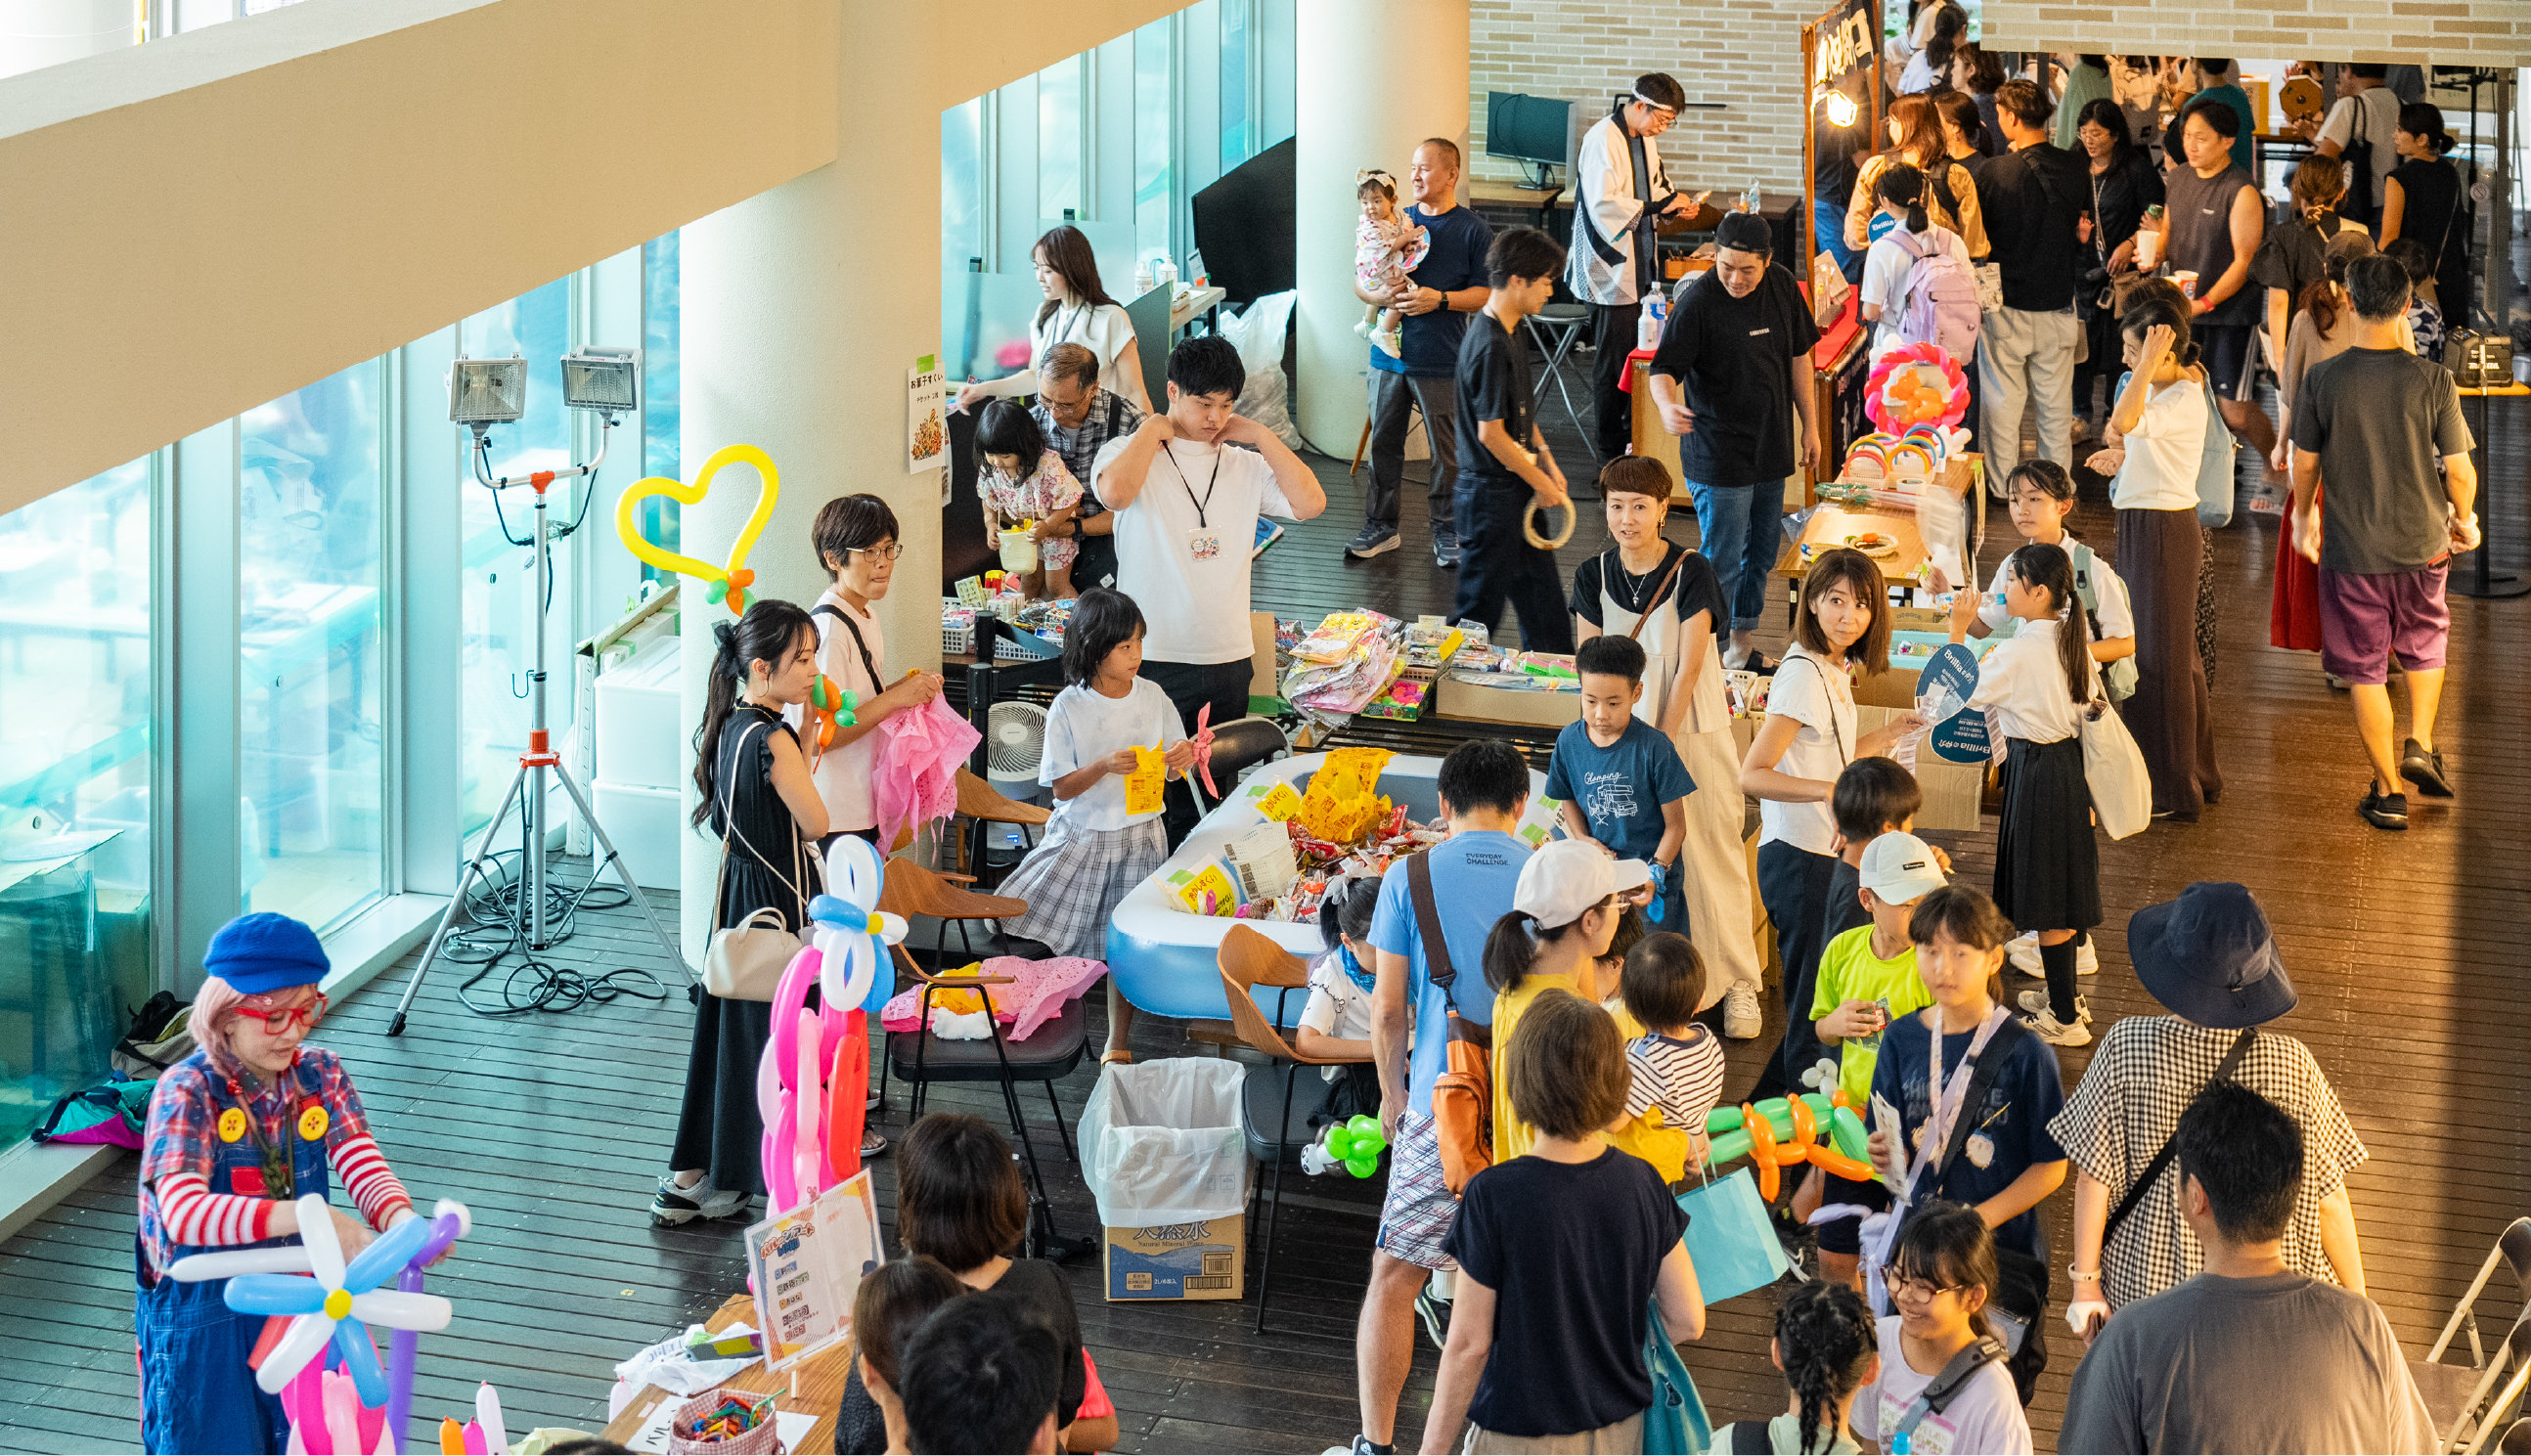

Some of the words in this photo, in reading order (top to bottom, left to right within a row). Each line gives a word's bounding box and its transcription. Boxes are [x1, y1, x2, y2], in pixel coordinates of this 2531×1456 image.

[1872, 220, 1894, 231] Brillia
[910, 374, 943, 389] お菓子すくい
[1584, 772, 1624, 785] Glamping
[1266, 791, 1290, 814] おかしすくい
[1189, 874, 1217, 902] おかしすくい
[761, 1222, 815, 1260] バルーンアート
[785, 1293, 802, 1306] おはな
